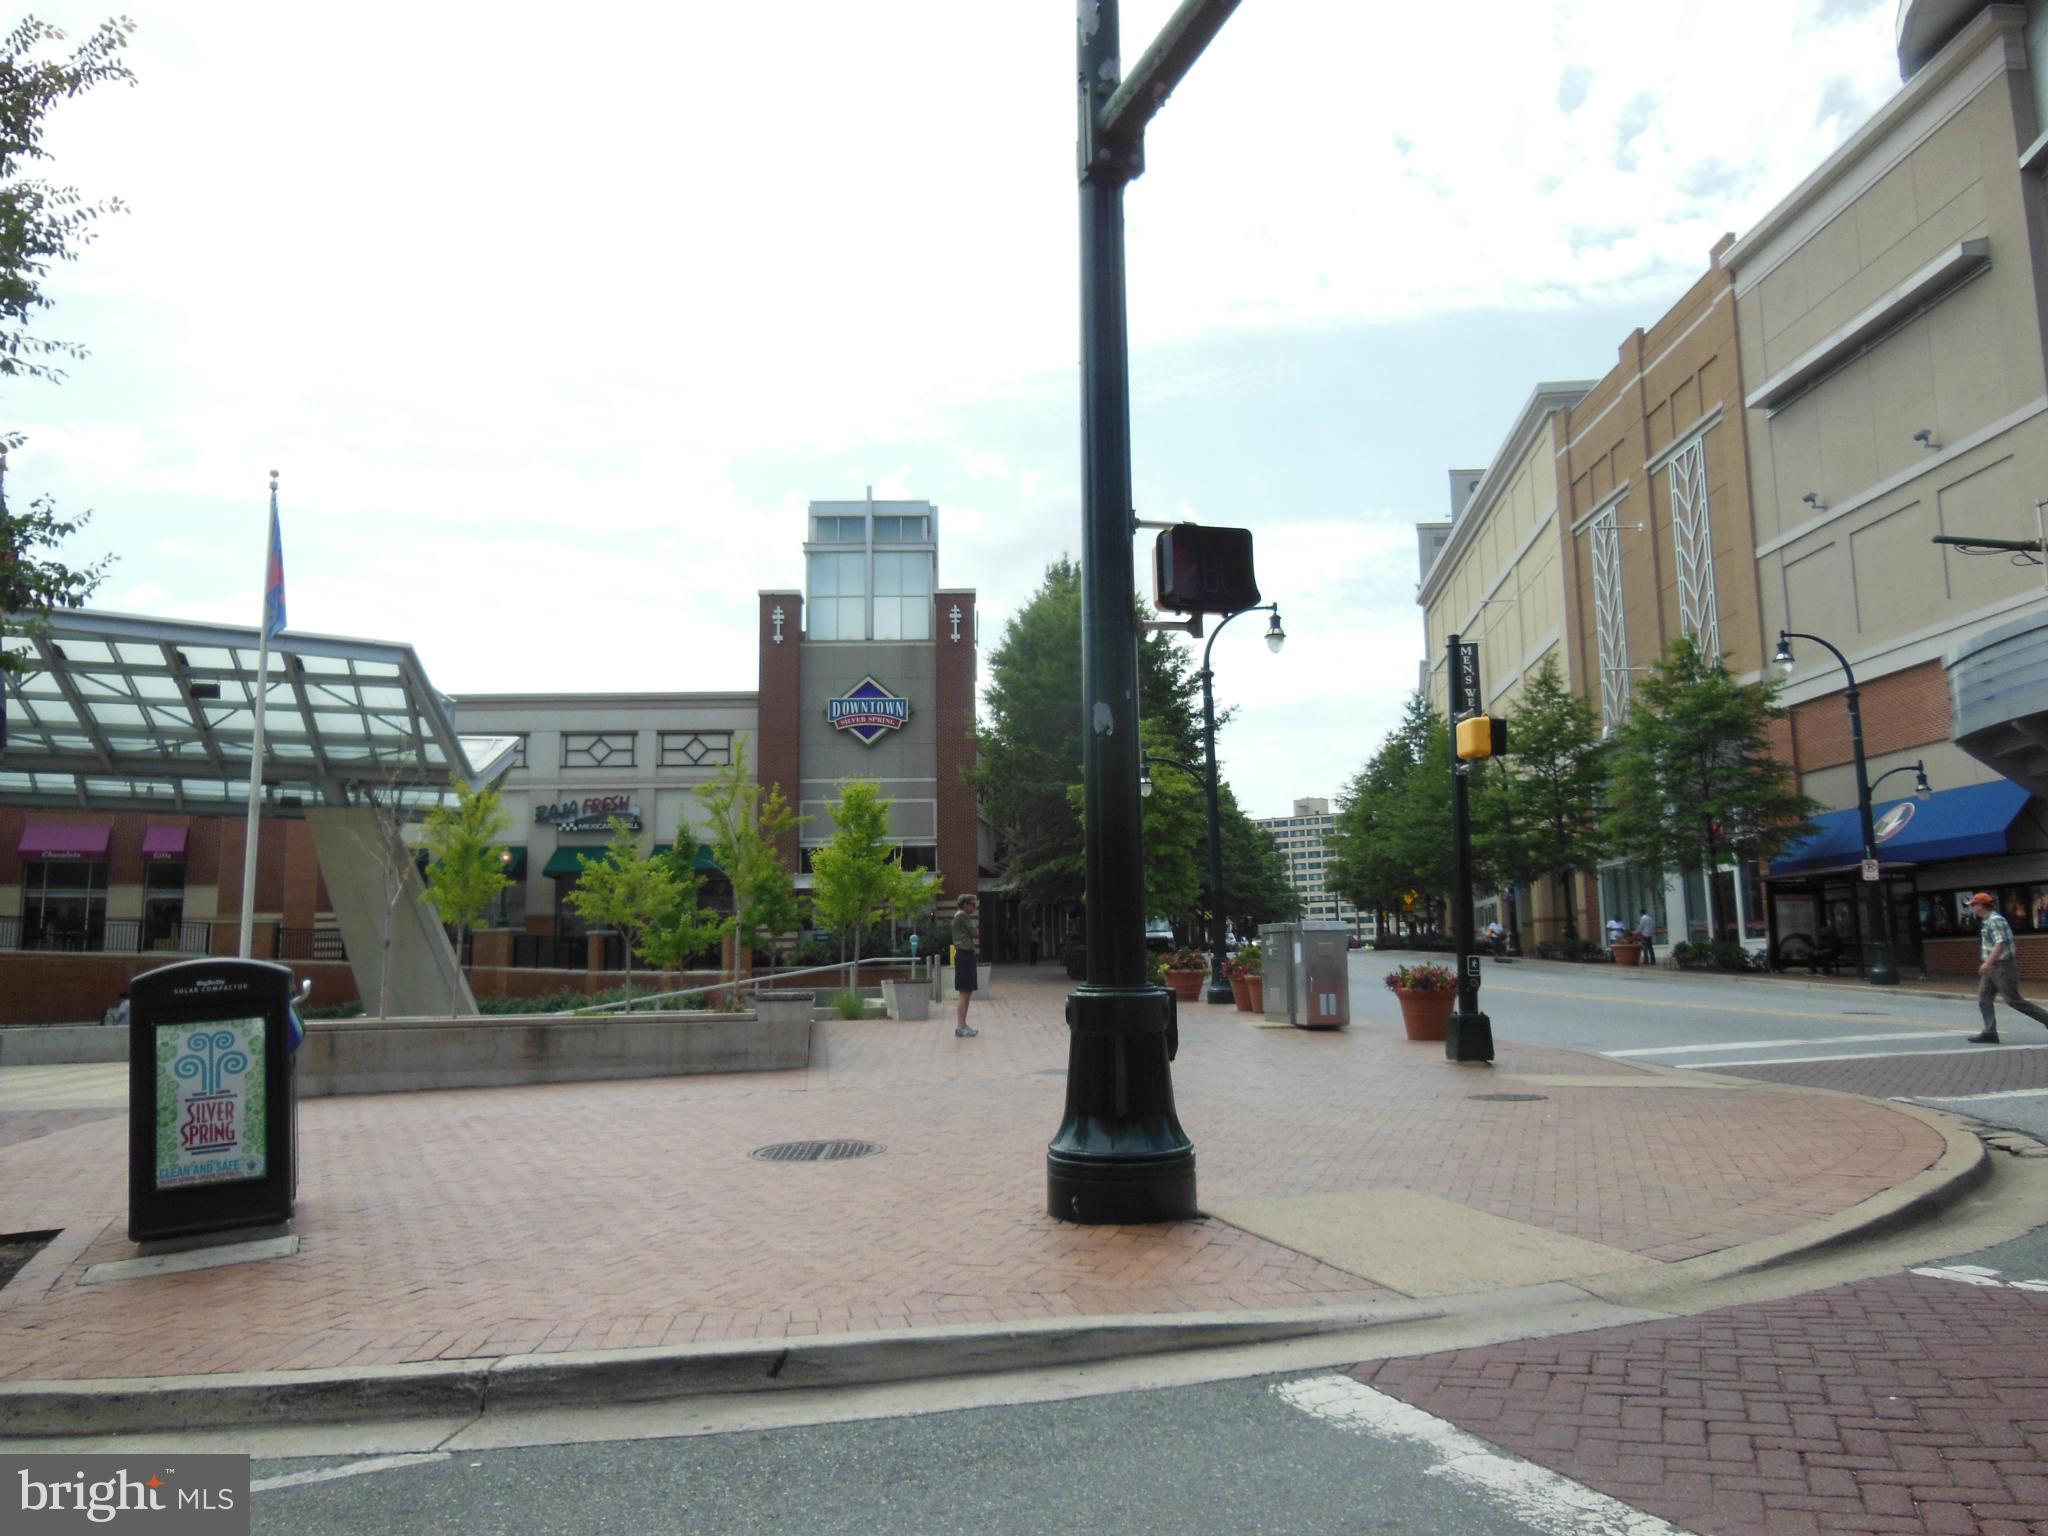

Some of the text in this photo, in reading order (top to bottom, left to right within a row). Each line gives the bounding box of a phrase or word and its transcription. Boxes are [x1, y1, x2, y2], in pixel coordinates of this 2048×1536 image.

[832, 701, 904, 718] DOWNTOWN
[840, 716, 896, 726] SILVER SPRING
[582, 795, 631, 815] FRESH
[578, 823, 613, 831] MEXICA
[173, 983, 248, 995] SOLAR COMPACTOR
[187, 1101, 235, 1125] SILVER
[180, 1121, 236, 1146] SPRING
[159, 1165, 191, 1179] CLEAN
[193, 1162, 213, 1175] AND
[215, 1159, 240, 1173] SAFE
